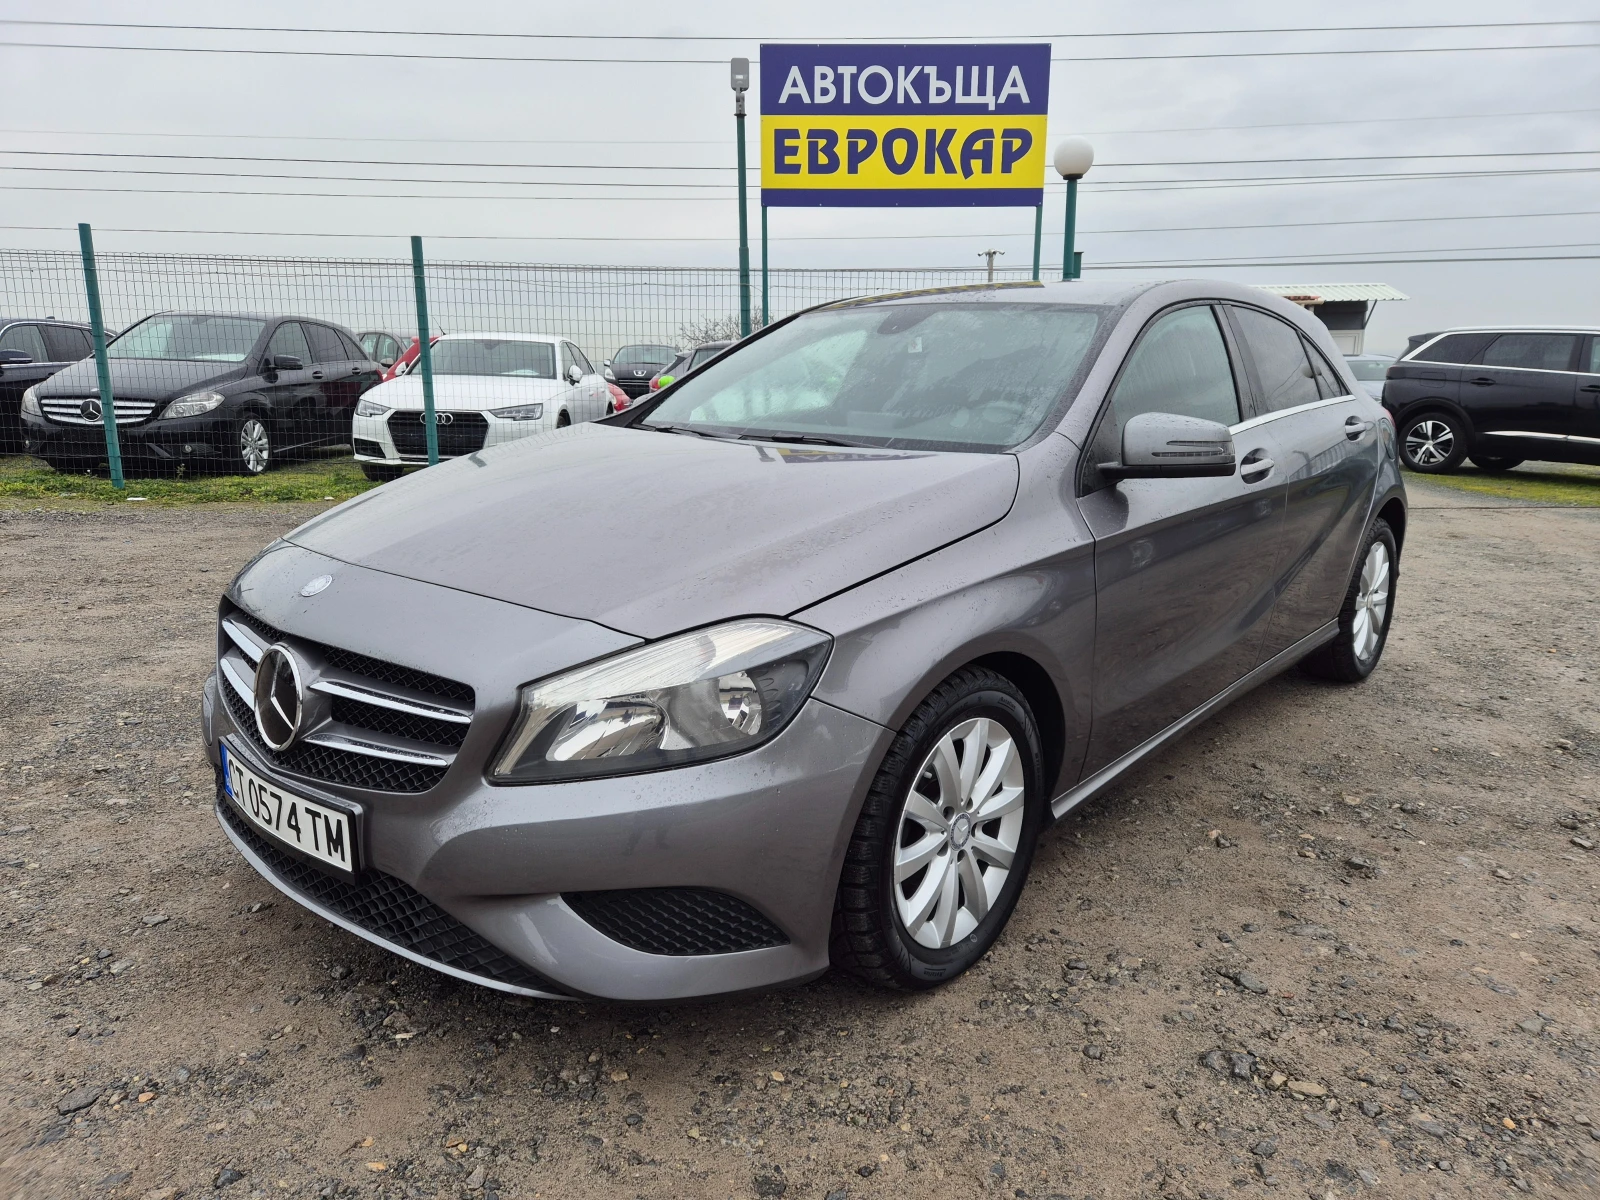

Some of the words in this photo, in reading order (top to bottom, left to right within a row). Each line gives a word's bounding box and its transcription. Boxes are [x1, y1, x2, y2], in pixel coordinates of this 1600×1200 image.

[778, 65, 1030, 111] АВТОКЪЩА
[773, 127, 1033, 180] ЕВРОКАР
[248, 778, 302, 844] 0574
[304, 806, 346, 863] TM
